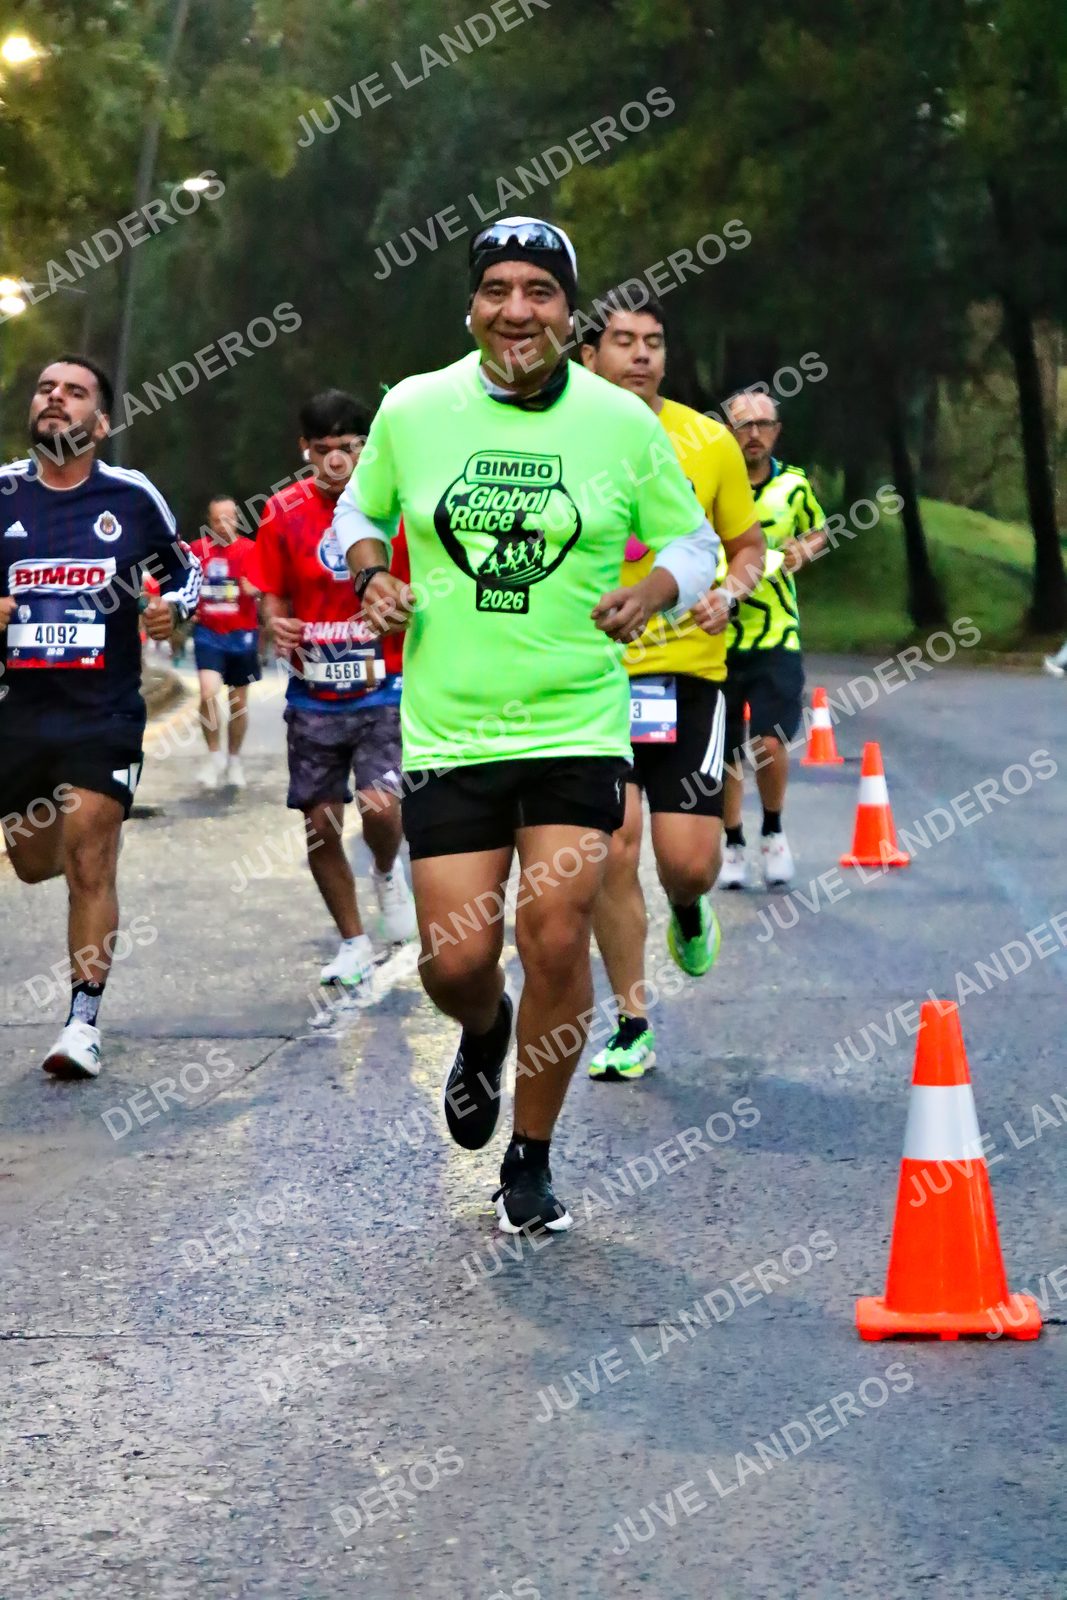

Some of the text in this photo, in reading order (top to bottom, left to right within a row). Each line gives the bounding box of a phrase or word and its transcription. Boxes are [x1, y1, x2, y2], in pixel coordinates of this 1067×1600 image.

[475, 461, 553, 478] BIMBO
[468, 486, 550, 512] Global
[450, 505, 516, 532] Race
[15, 566, 105, 586] BIMBO
[479, 589, 525, 610] 2026
[35, 625, 78, 644] 4092
[325, 663, 361, 679] 4568
